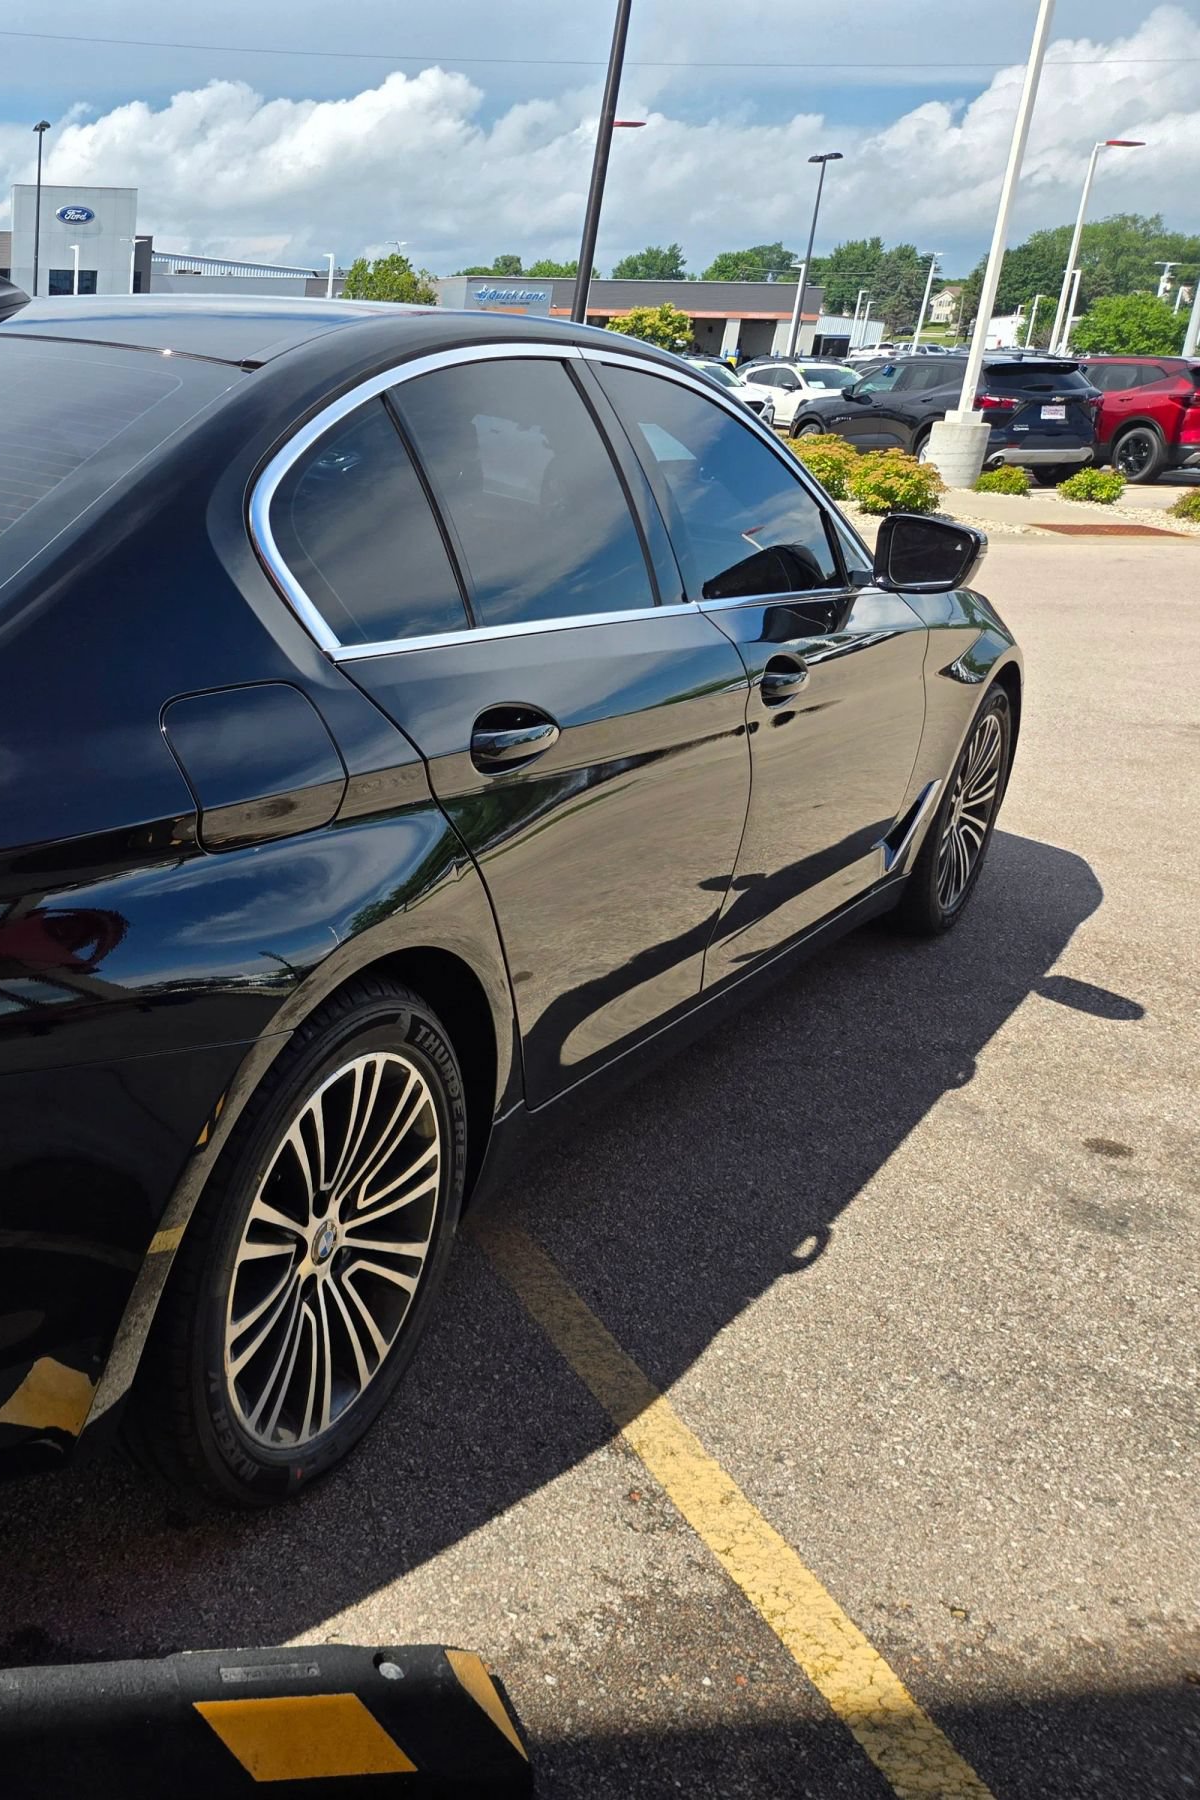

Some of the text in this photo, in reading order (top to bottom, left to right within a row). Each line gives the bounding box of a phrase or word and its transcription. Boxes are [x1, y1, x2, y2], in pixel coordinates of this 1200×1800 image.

[64, 209, 88, 220] Ford
[488, 289, 547, 301] Quick Lane
[413, 1024, 466, 1192] THUNDERER
